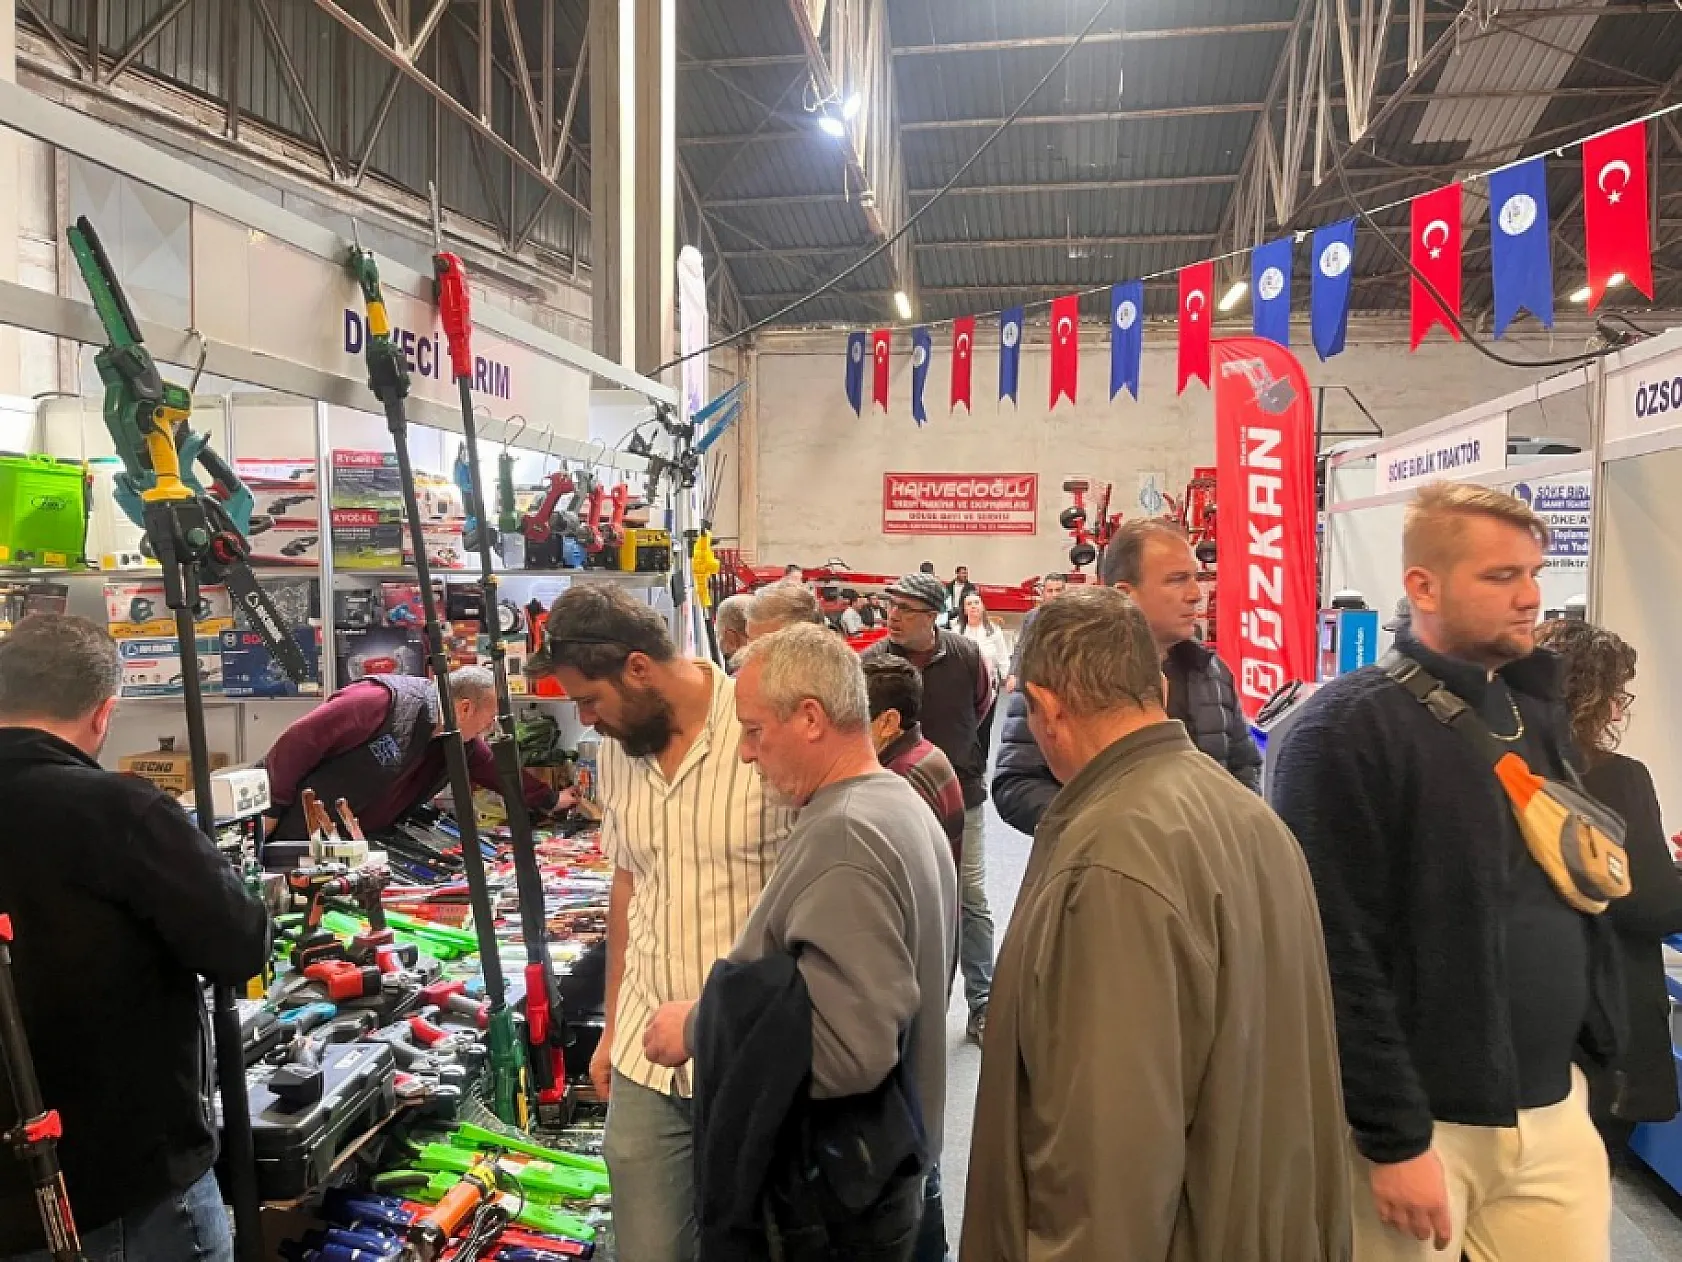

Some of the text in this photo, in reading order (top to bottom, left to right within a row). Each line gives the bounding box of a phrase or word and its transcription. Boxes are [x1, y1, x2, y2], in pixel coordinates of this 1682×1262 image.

[344, 308, 439, 379] DECİ
[1437, 436, 1481, 470] TRAKTÖR
[1537, 484, 1566, 499] SÖKE
[1241, 427, 1284, 650] ÖZKAN
